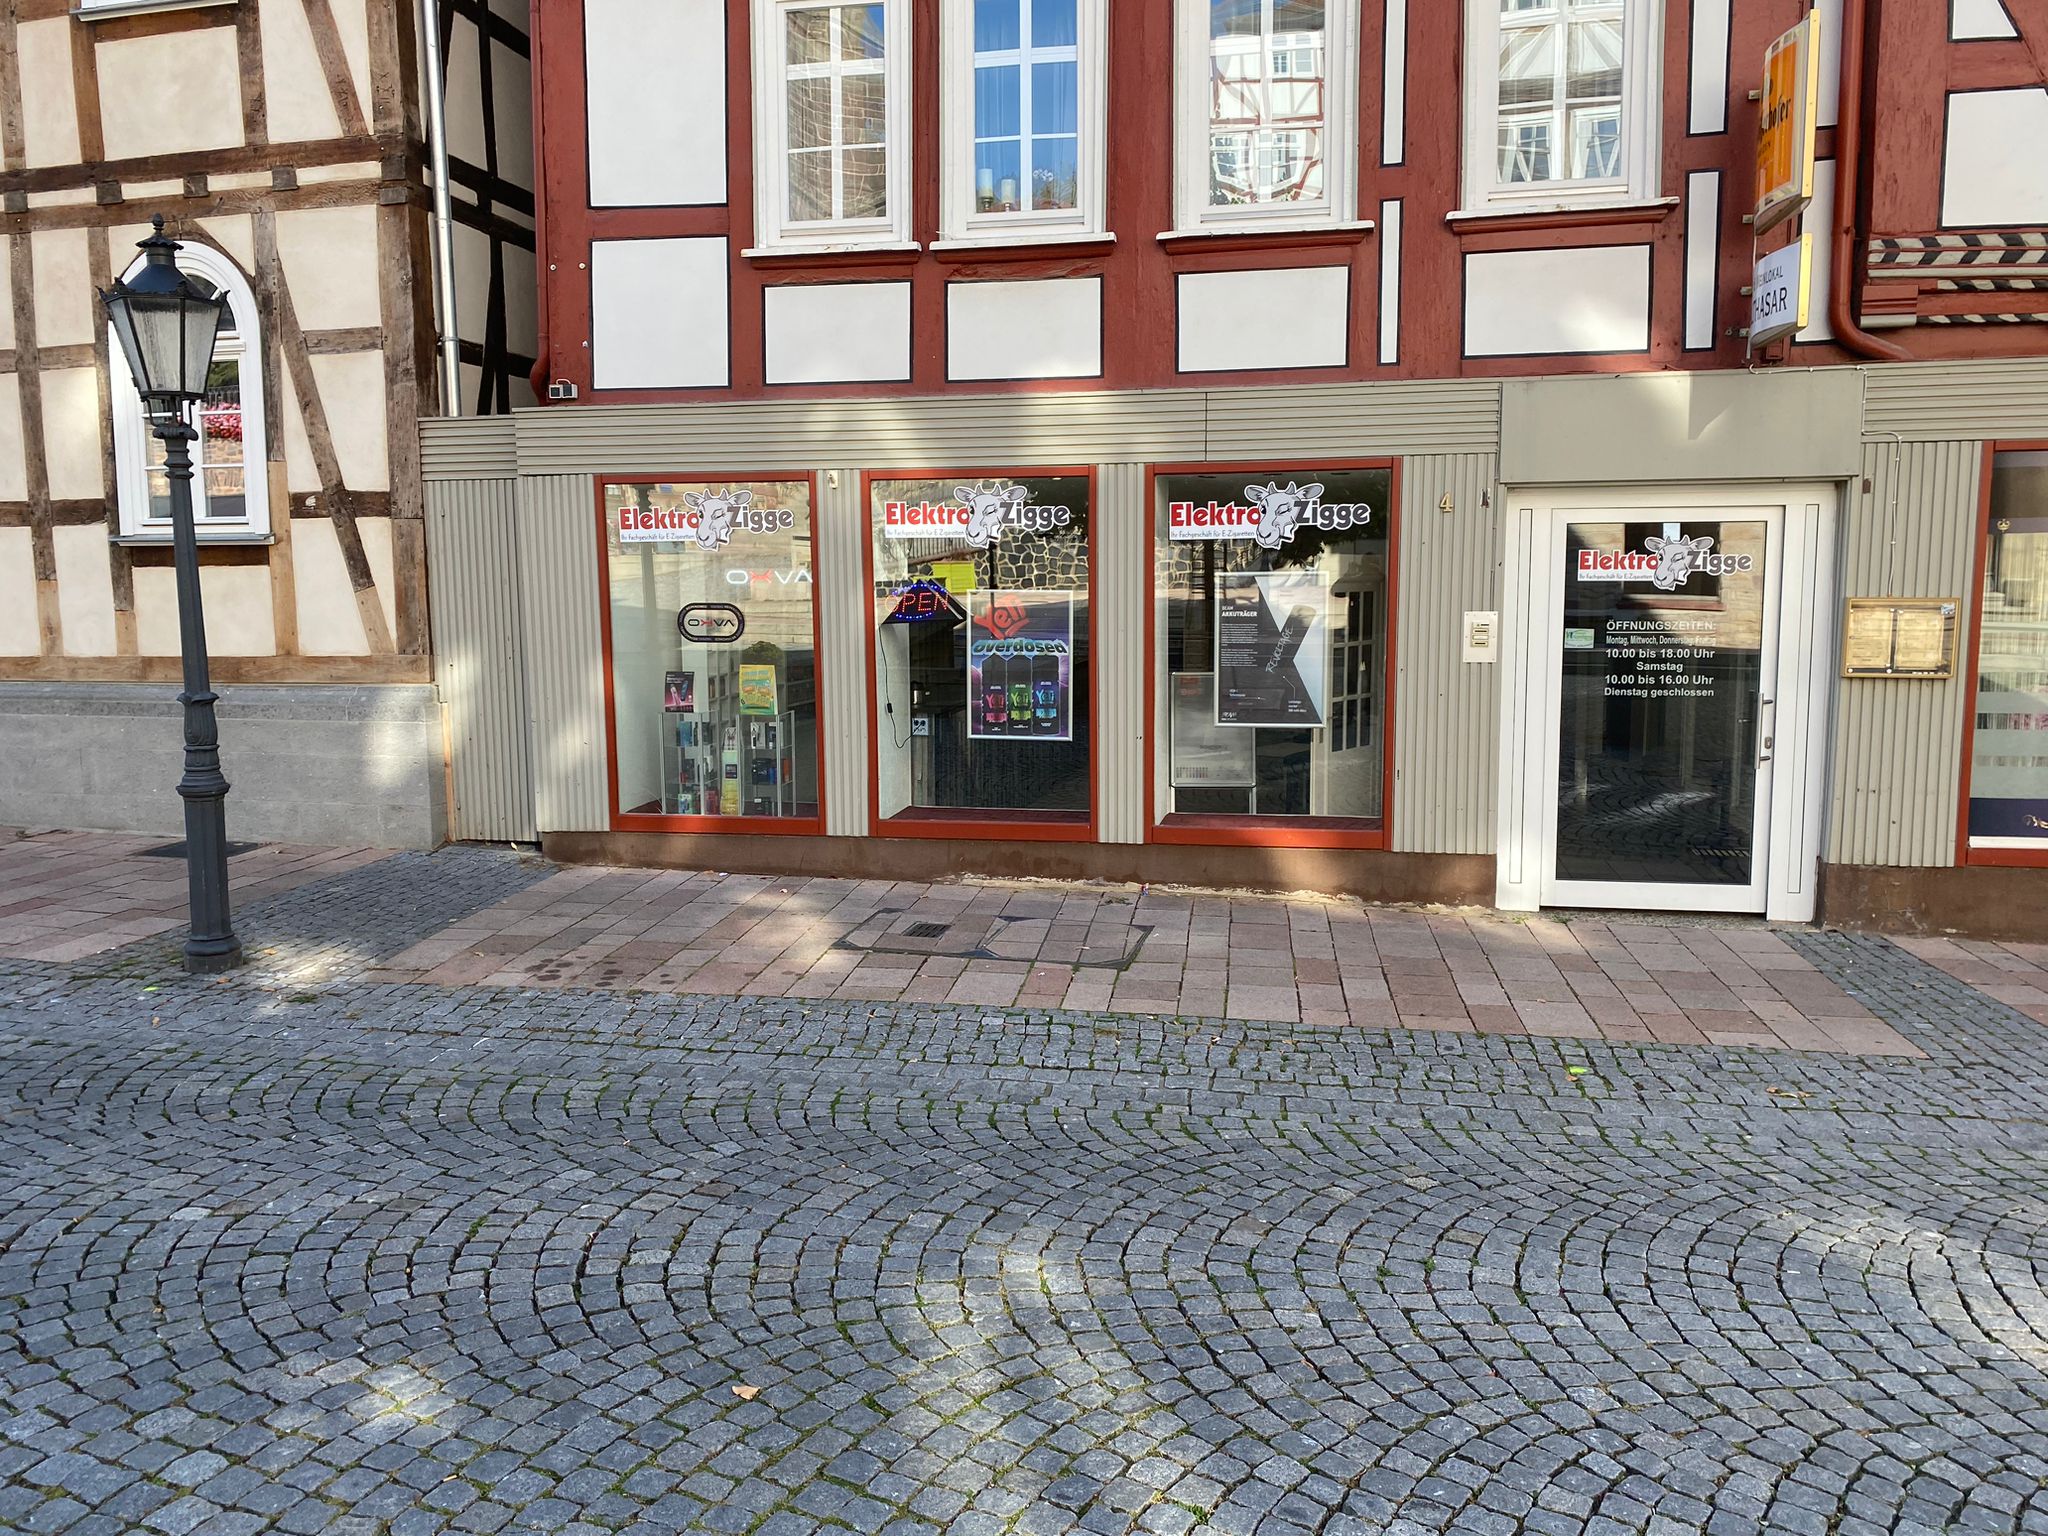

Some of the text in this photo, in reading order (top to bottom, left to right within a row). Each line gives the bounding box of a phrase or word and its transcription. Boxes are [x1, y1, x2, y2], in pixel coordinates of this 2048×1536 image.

[1439, 492, 1454, 513] 4
[620, 506, 793, 533] Elektro Zigge
[885, 501, 1069, 530] Elektro Zigge
[1170, 500, 1369, 529] Elektro Zigge
[1179, 530, 1213, 539] Fachgeschäft
[1213, 530, 1221, 538] für
[1221, 530, 1255, 538] E-Zigaretten
[1579, 550, 1752, 575] Elektro Zigge
[725, 569, 812, 585] OXVA
[885, 590, 950, 613] OPEN
[688, 618, 735, 627] OXVA
[1606, 619, 1717, 631] ÖFFNUNGSZEITEN:
[1606, 635, 1629, 646] Montag,
[1630, 635, 1658, 645] Mittwoch,
[1265, 625, 1294, 674] REVOLTAGE
[1606, 649, 1715, 659] 10.00 bis 18.00 Uhr
[1636, 662, 1684, 673] Samstag
[1605, 675, 1714, 685] 10.00 bis 16.00 Uhr
[1604, 687, 1715, 698] Dienstag geschlossen
